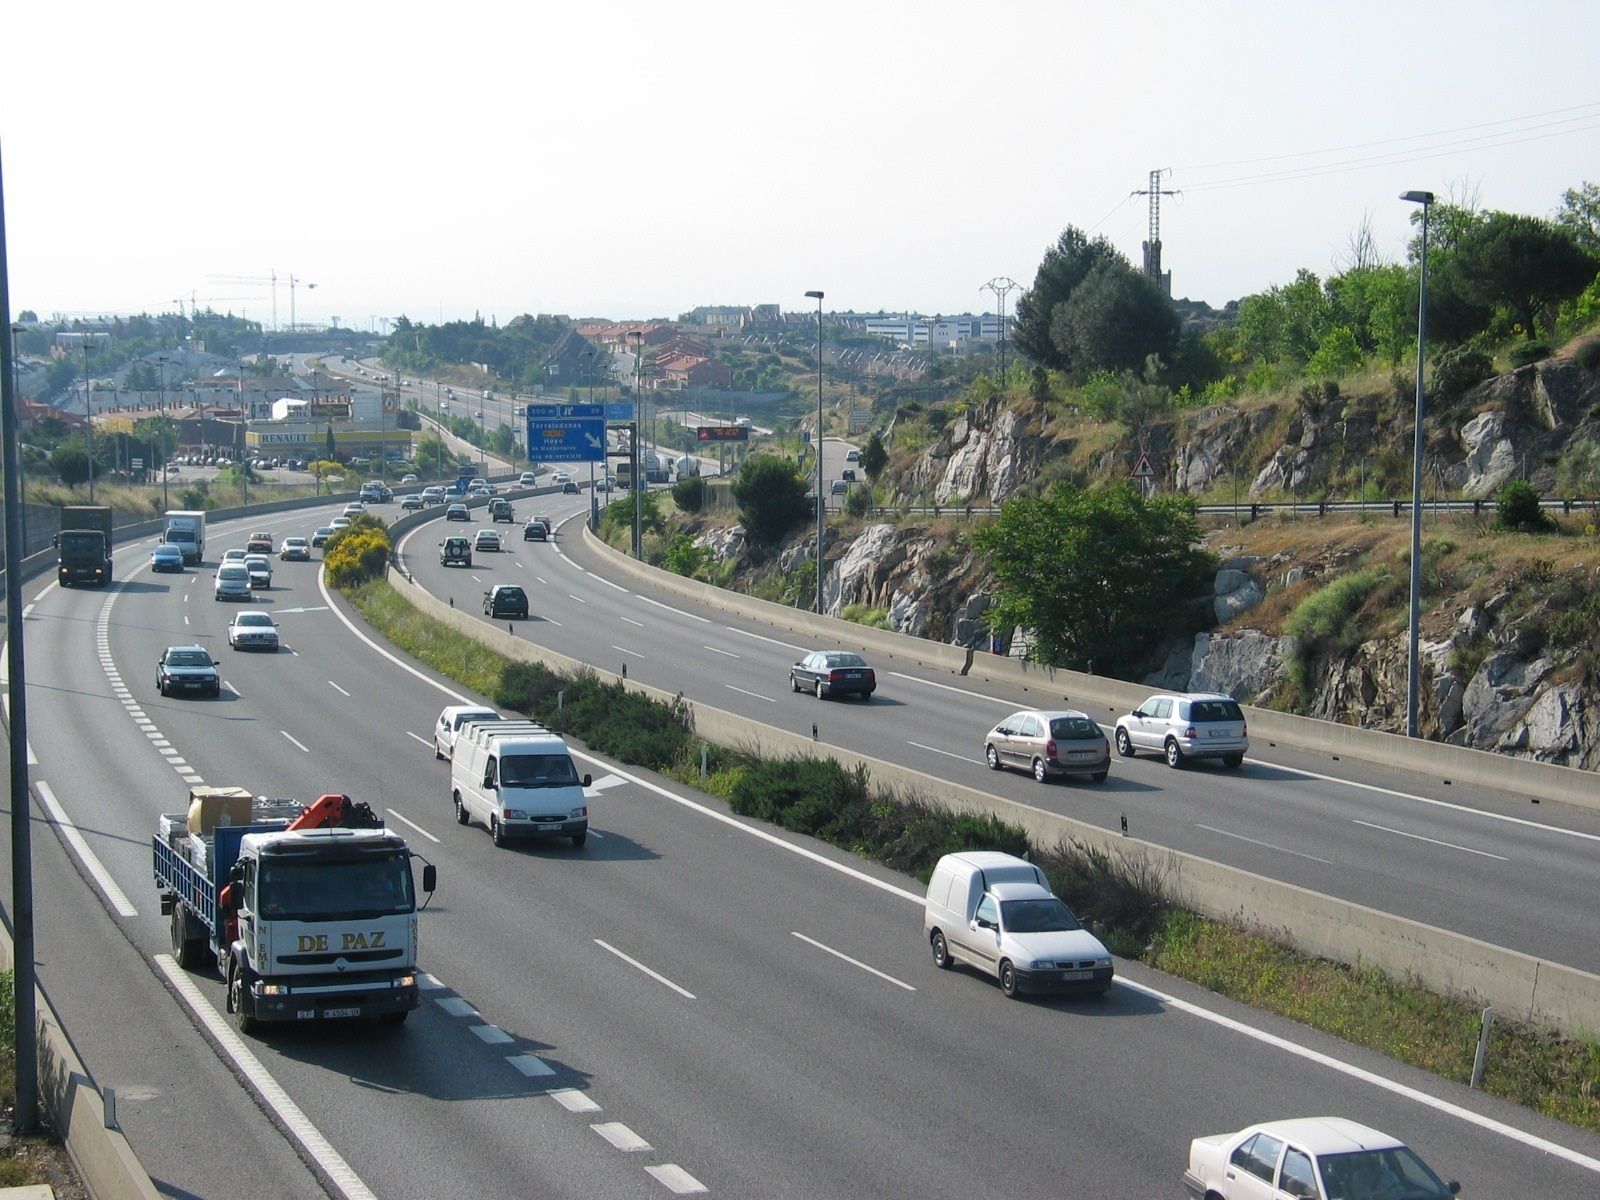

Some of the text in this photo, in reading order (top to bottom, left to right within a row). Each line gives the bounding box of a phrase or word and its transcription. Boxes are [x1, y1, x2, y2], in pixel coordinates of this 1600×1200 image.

[262, 434, 307, 443] RENAULT
[297, 931, 386, 952] DE PAZ
